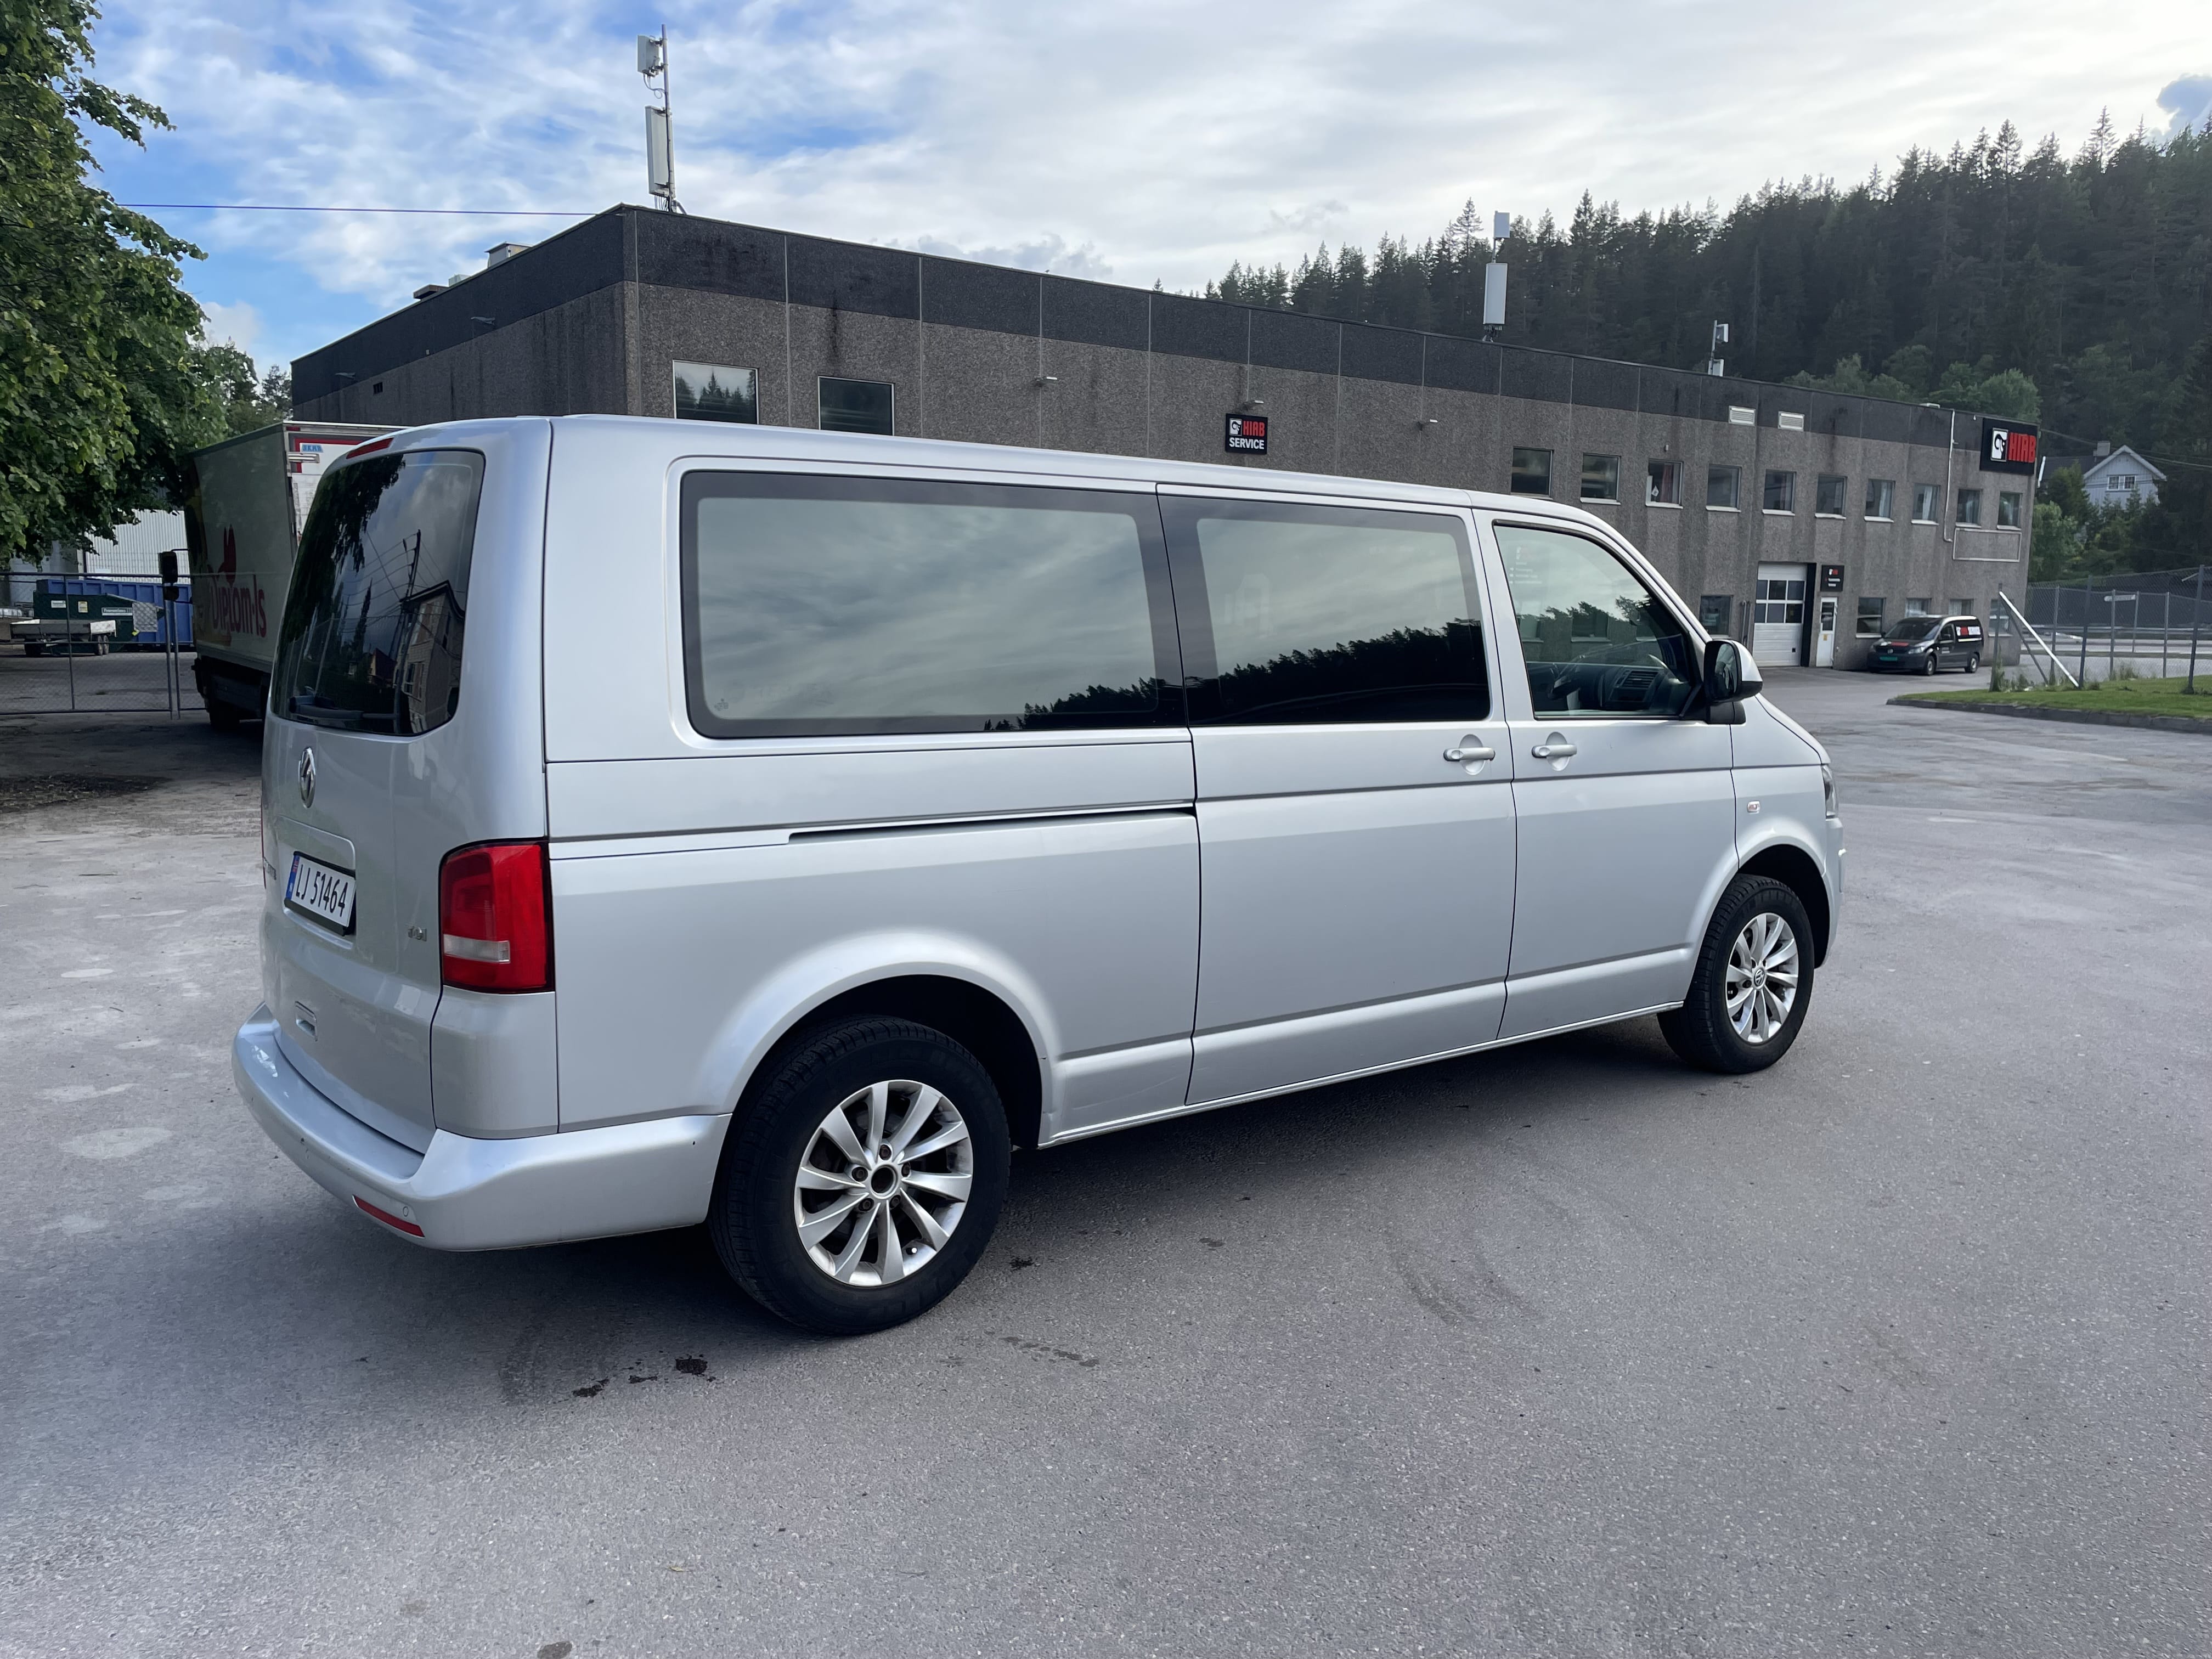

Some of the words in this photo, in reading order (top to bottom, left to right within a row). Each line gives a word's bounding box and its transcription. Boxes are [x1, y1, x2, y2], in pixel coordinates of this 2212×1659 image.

[1243, 421, 1265, 437] HIAB
[1229, 437, 1265, 449] SERVICE
[2008, 432, 2036, 463] HIAB
[296, 864, 311, 900] LJ
[310, 871, 348, 917] 51464
